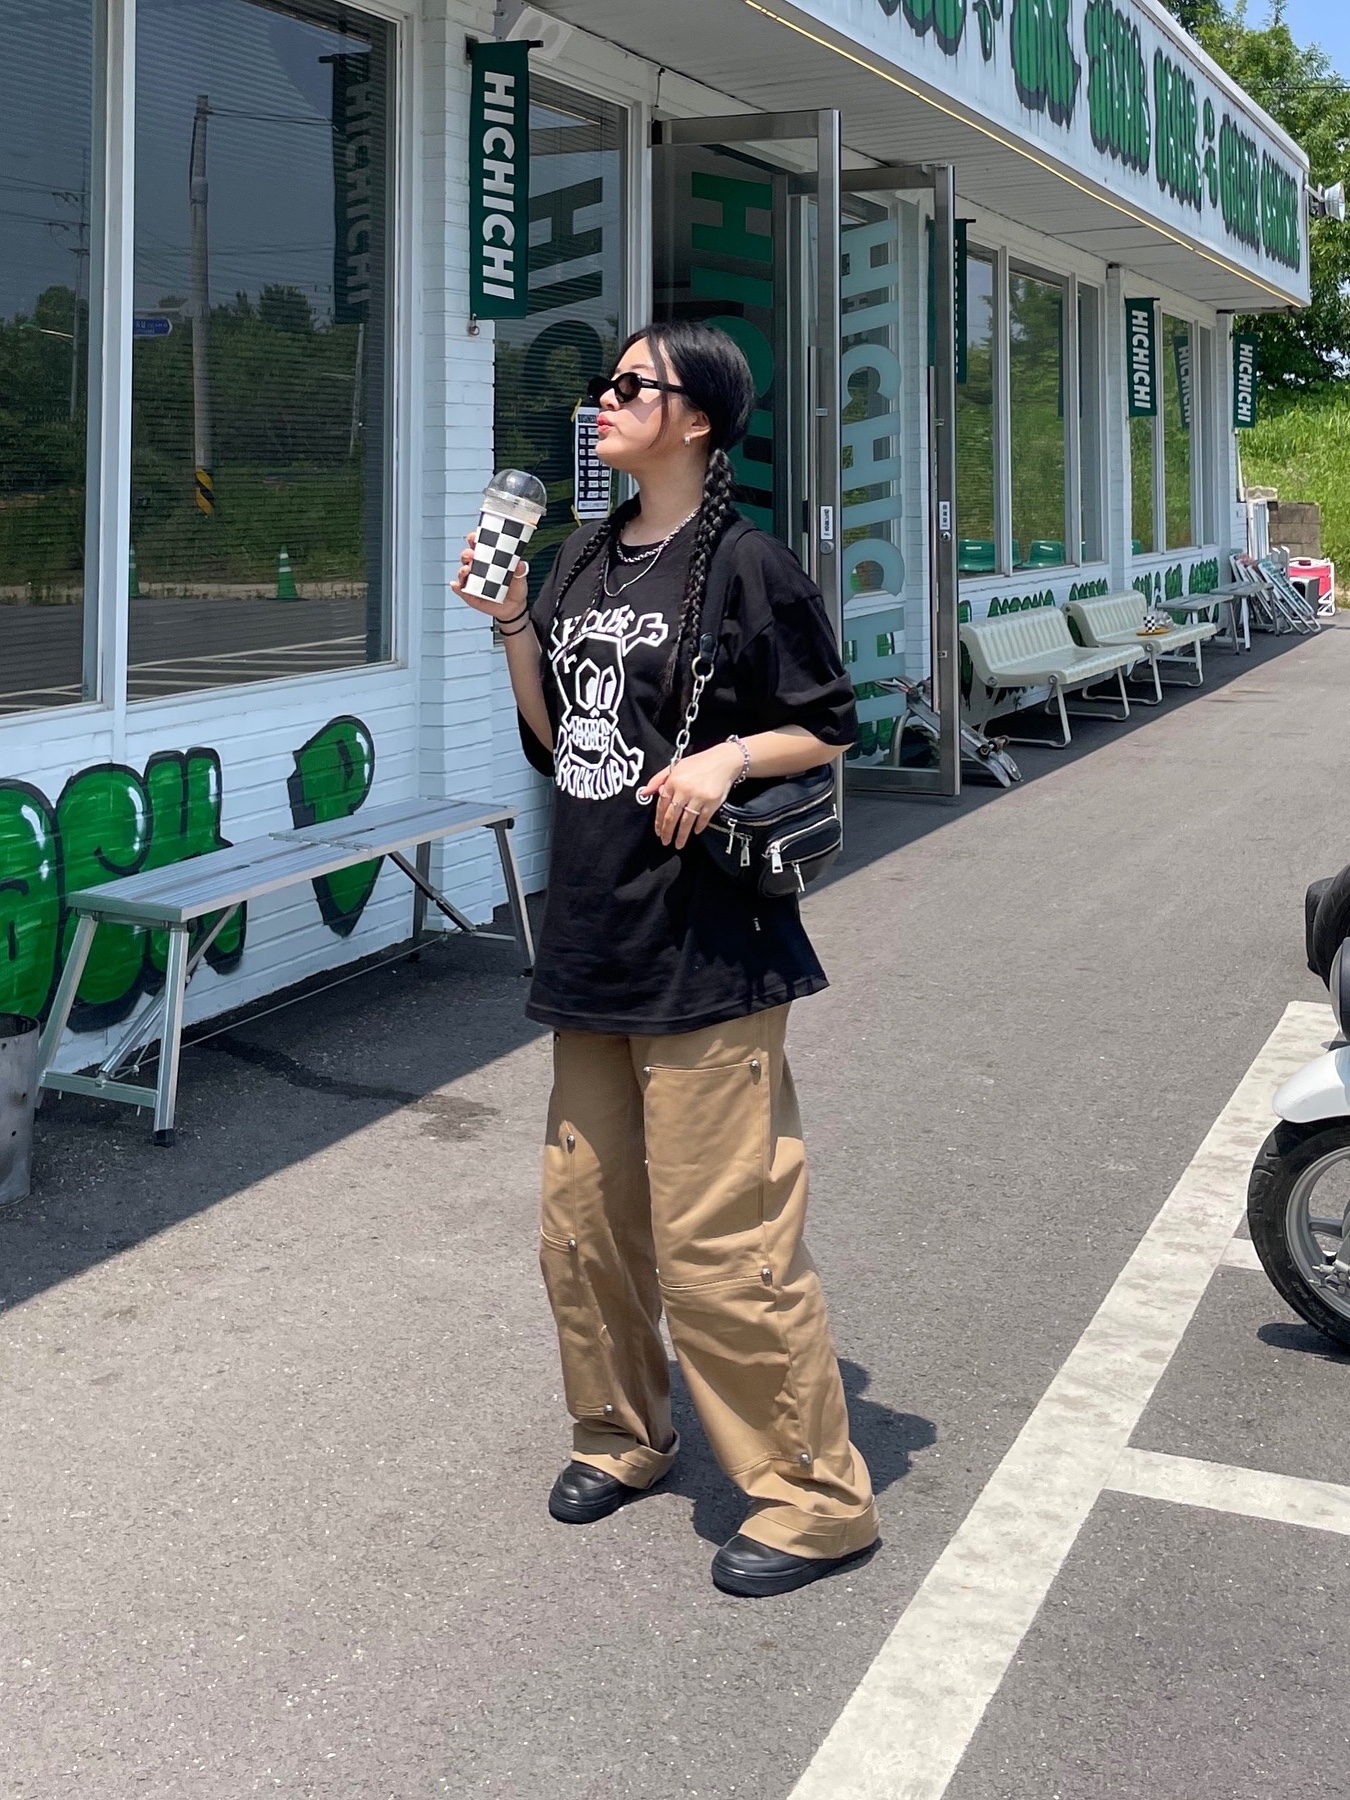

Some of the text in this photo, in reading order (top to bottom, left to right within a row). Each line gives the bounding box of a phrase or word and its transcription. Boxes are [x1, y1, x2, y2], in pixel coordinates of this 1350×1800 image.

[483, 71, 515, 300] HICHICHI
[1131, 309, 1151, 409] HICHICHI
[1237, 343, 1253, 422] HICHICHI
